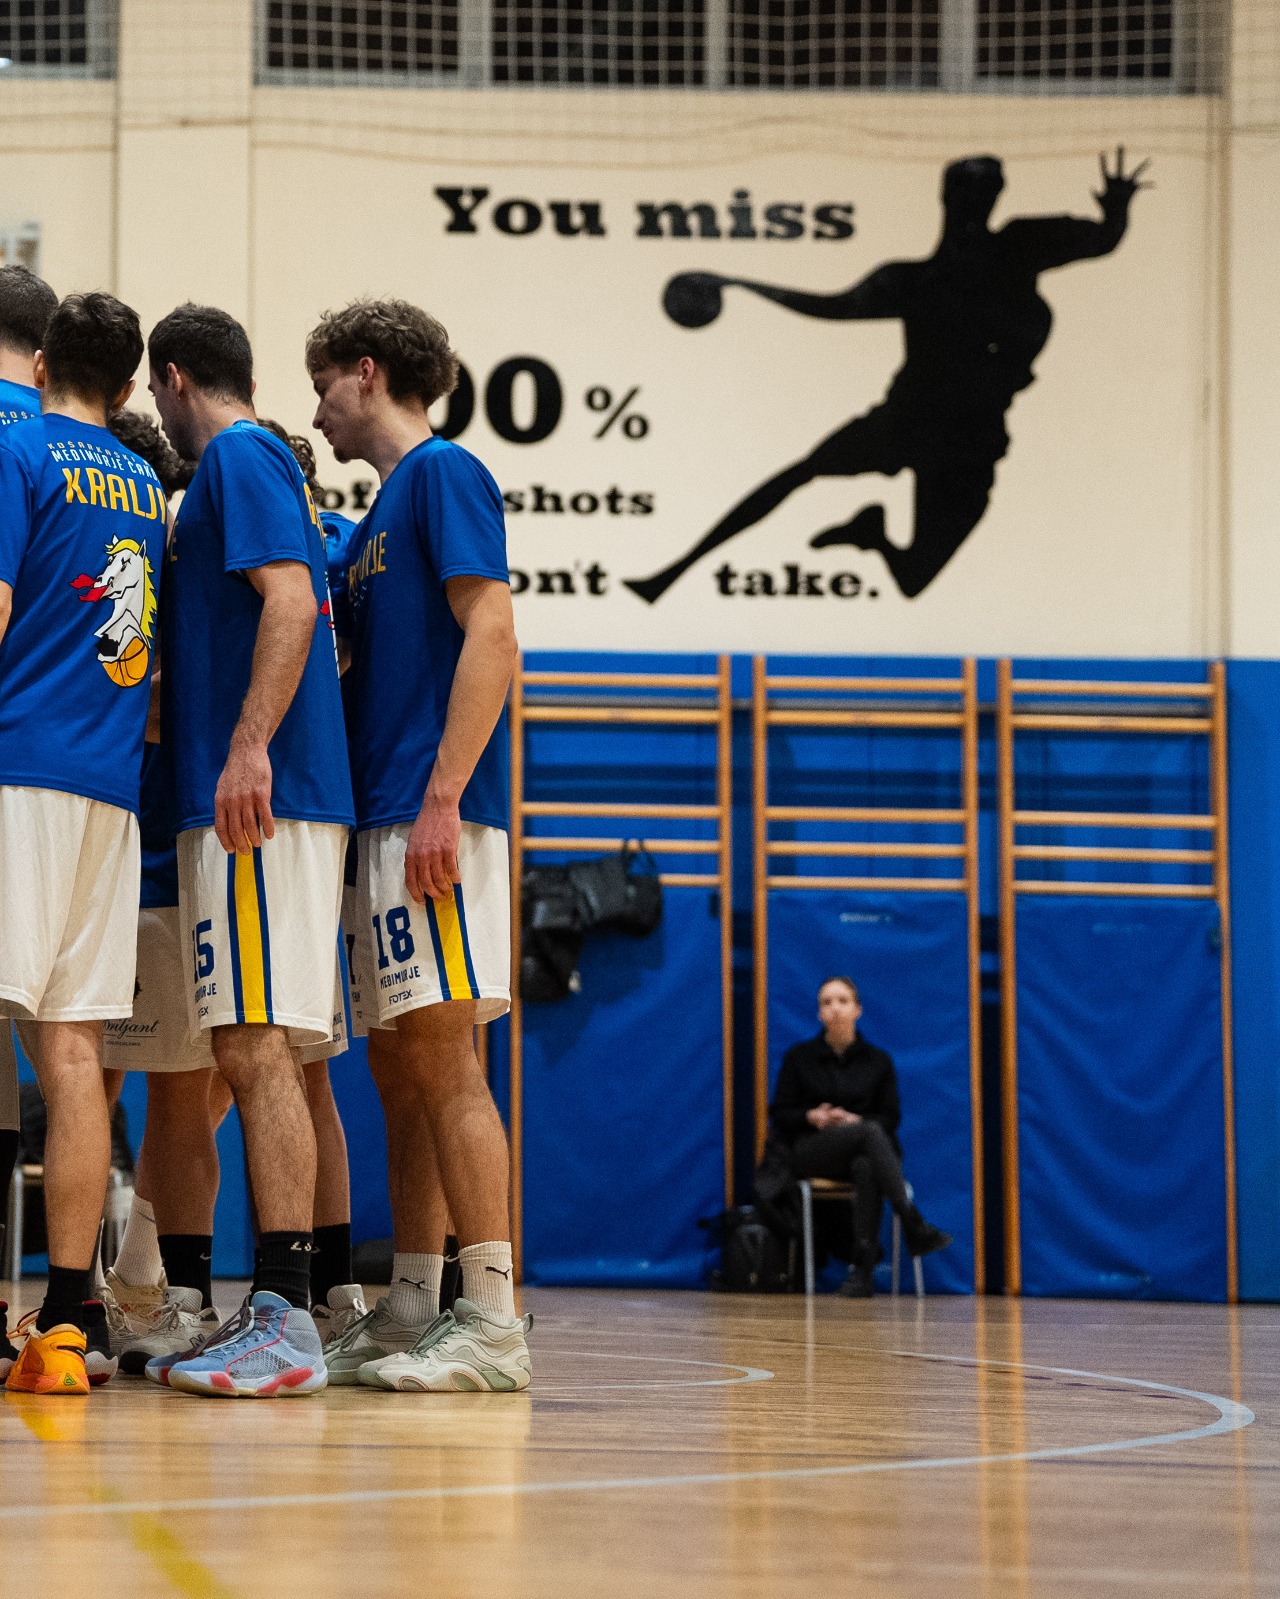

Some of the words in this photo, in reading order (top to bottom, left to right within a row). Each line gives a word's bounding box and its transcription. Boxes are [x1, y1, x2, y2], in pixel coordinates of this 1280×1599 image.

[434, 186, 607, 237] You
[635, 187, 856, 241] miss
[584, 385, 650, 442] %
[319, 480, 373, 510] of
[503, 485, 655, 515] shots
[508, 560, 608, 597] on't
[713, 563, 880, 598] take.
[372, 905, 415, 970] 18
